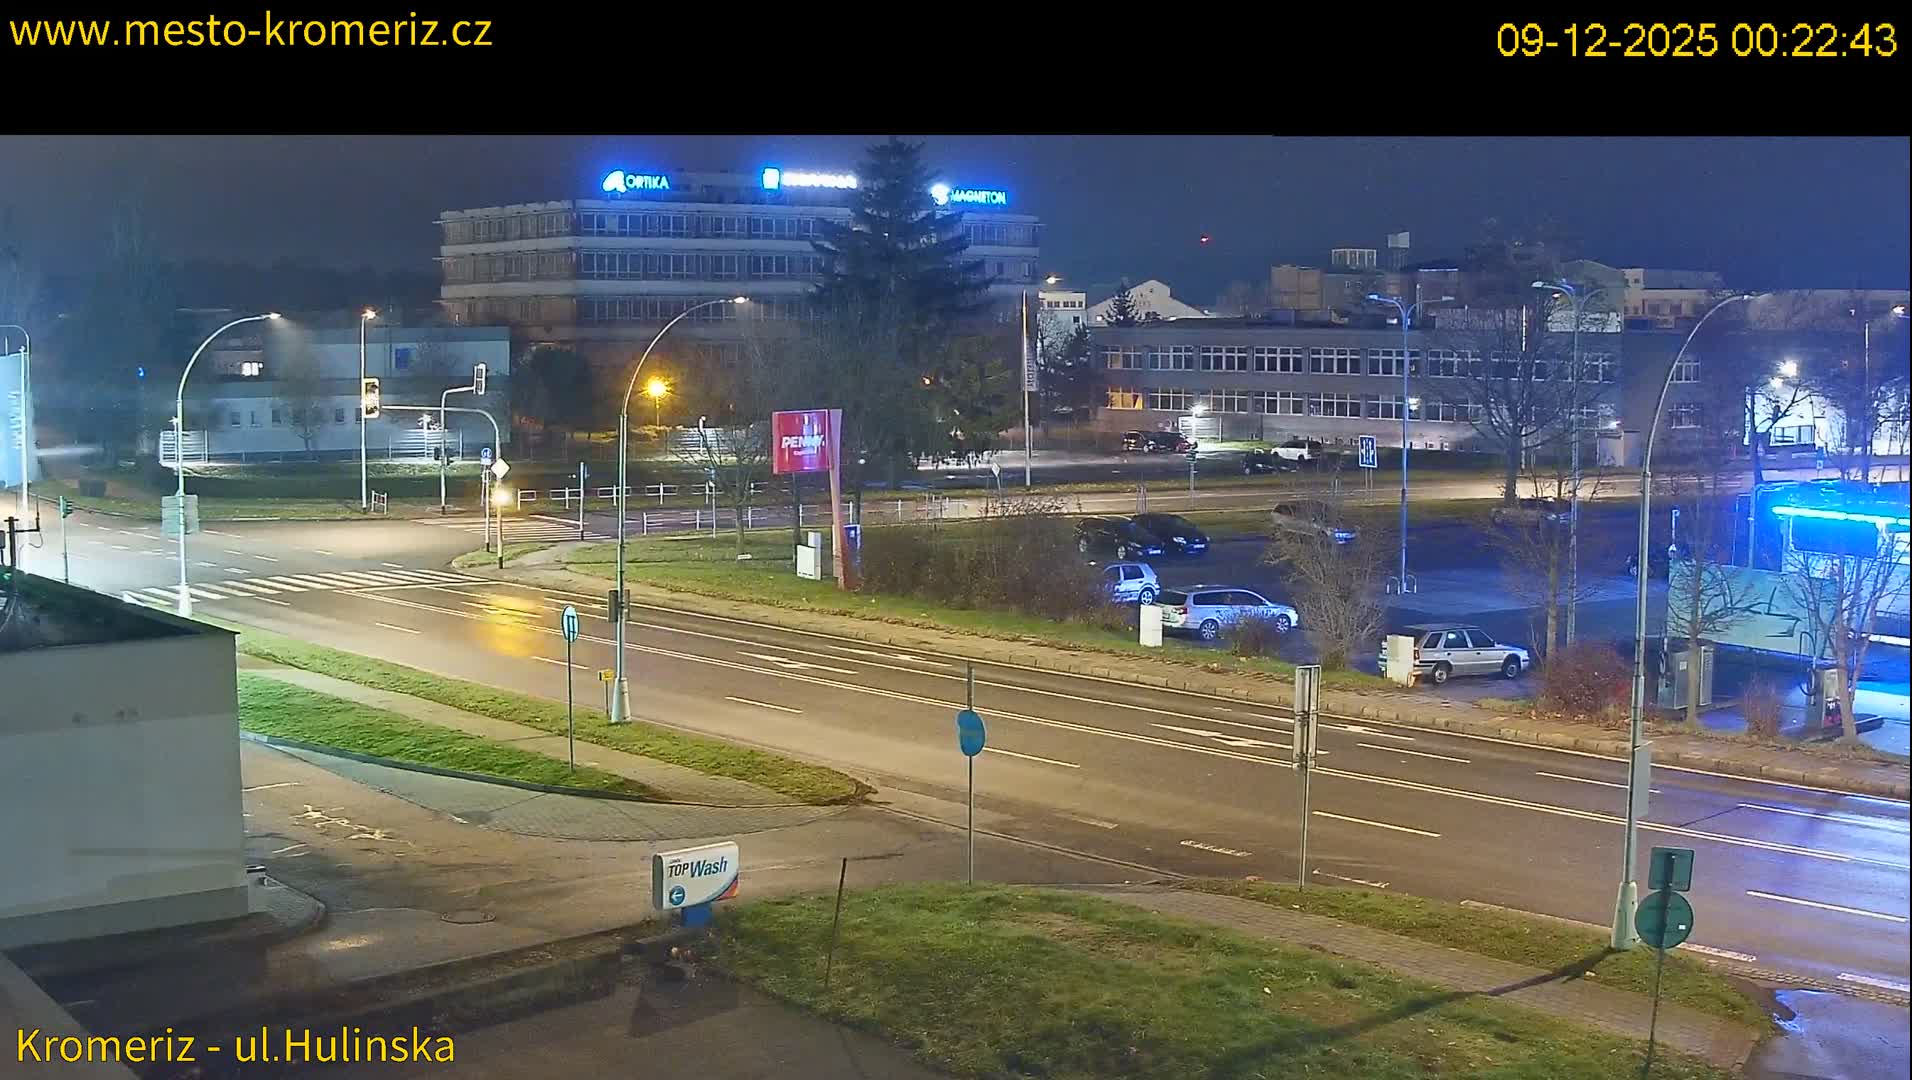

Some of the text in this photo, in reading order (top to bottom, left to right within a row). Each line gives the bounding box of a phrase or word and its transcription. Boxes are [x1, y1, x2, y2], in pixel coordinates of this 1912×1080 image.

[626, 174, 669, 190] ORTIKA
[951, 189, 1007, 205] MAGNETON
[668, 856, 728, 878] TOP Wash
